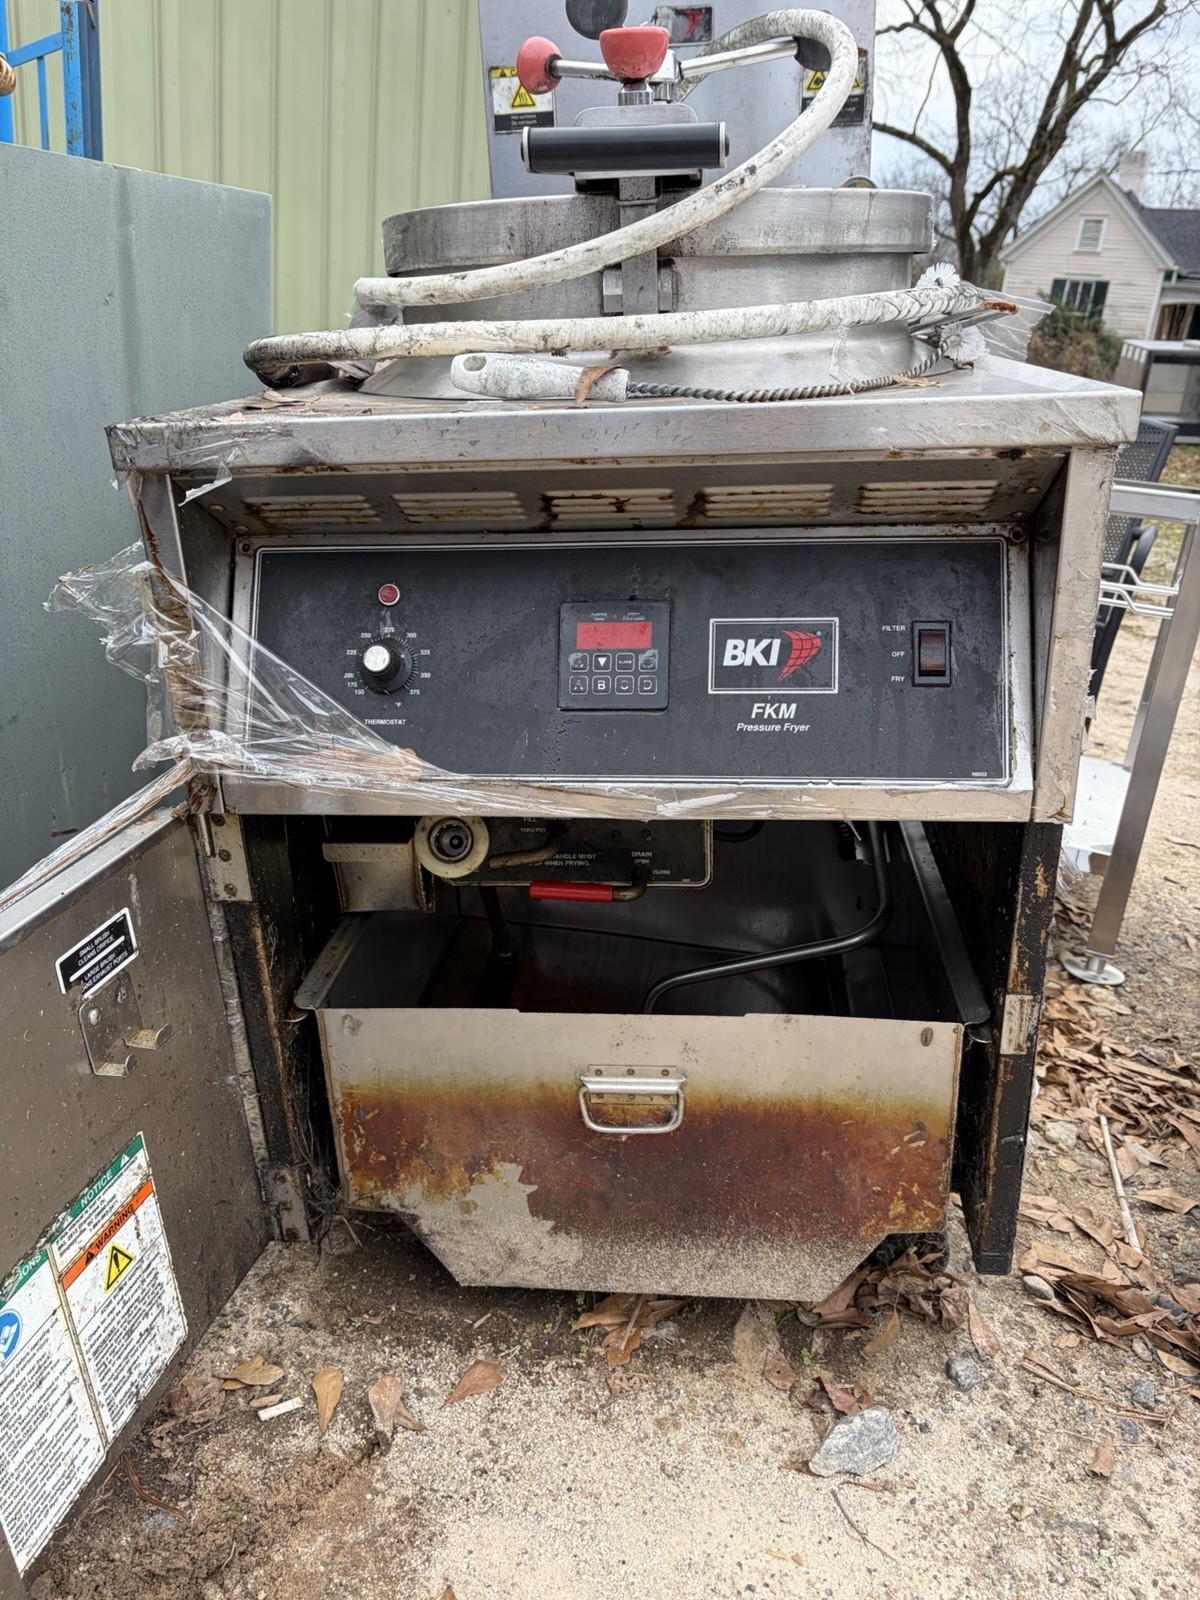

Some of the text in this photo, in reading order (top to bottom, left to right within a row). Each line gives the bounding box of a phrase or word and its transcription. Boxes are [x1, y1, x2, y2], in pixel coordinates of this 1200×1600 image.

[722, 638, 782, 667] BKI
[597, 680, 606, 690] B
[750, 703, 798, 720] FKM
[736, 722, 811, 733] Pressure Fryer
[78, 935, 115, 966] CLEANS ORIFICE
[79, 930, 111, 957] SMALL BRUSH
[84, 953, 116, 981] LARGE BRUSH
[92, 963, 114, 985] EXHAUST
[113, 951, 129, 966] PORTS
[80, 1169, 113, 1208] NOTICE
[95, 1204, 135, 1250] WARNING
